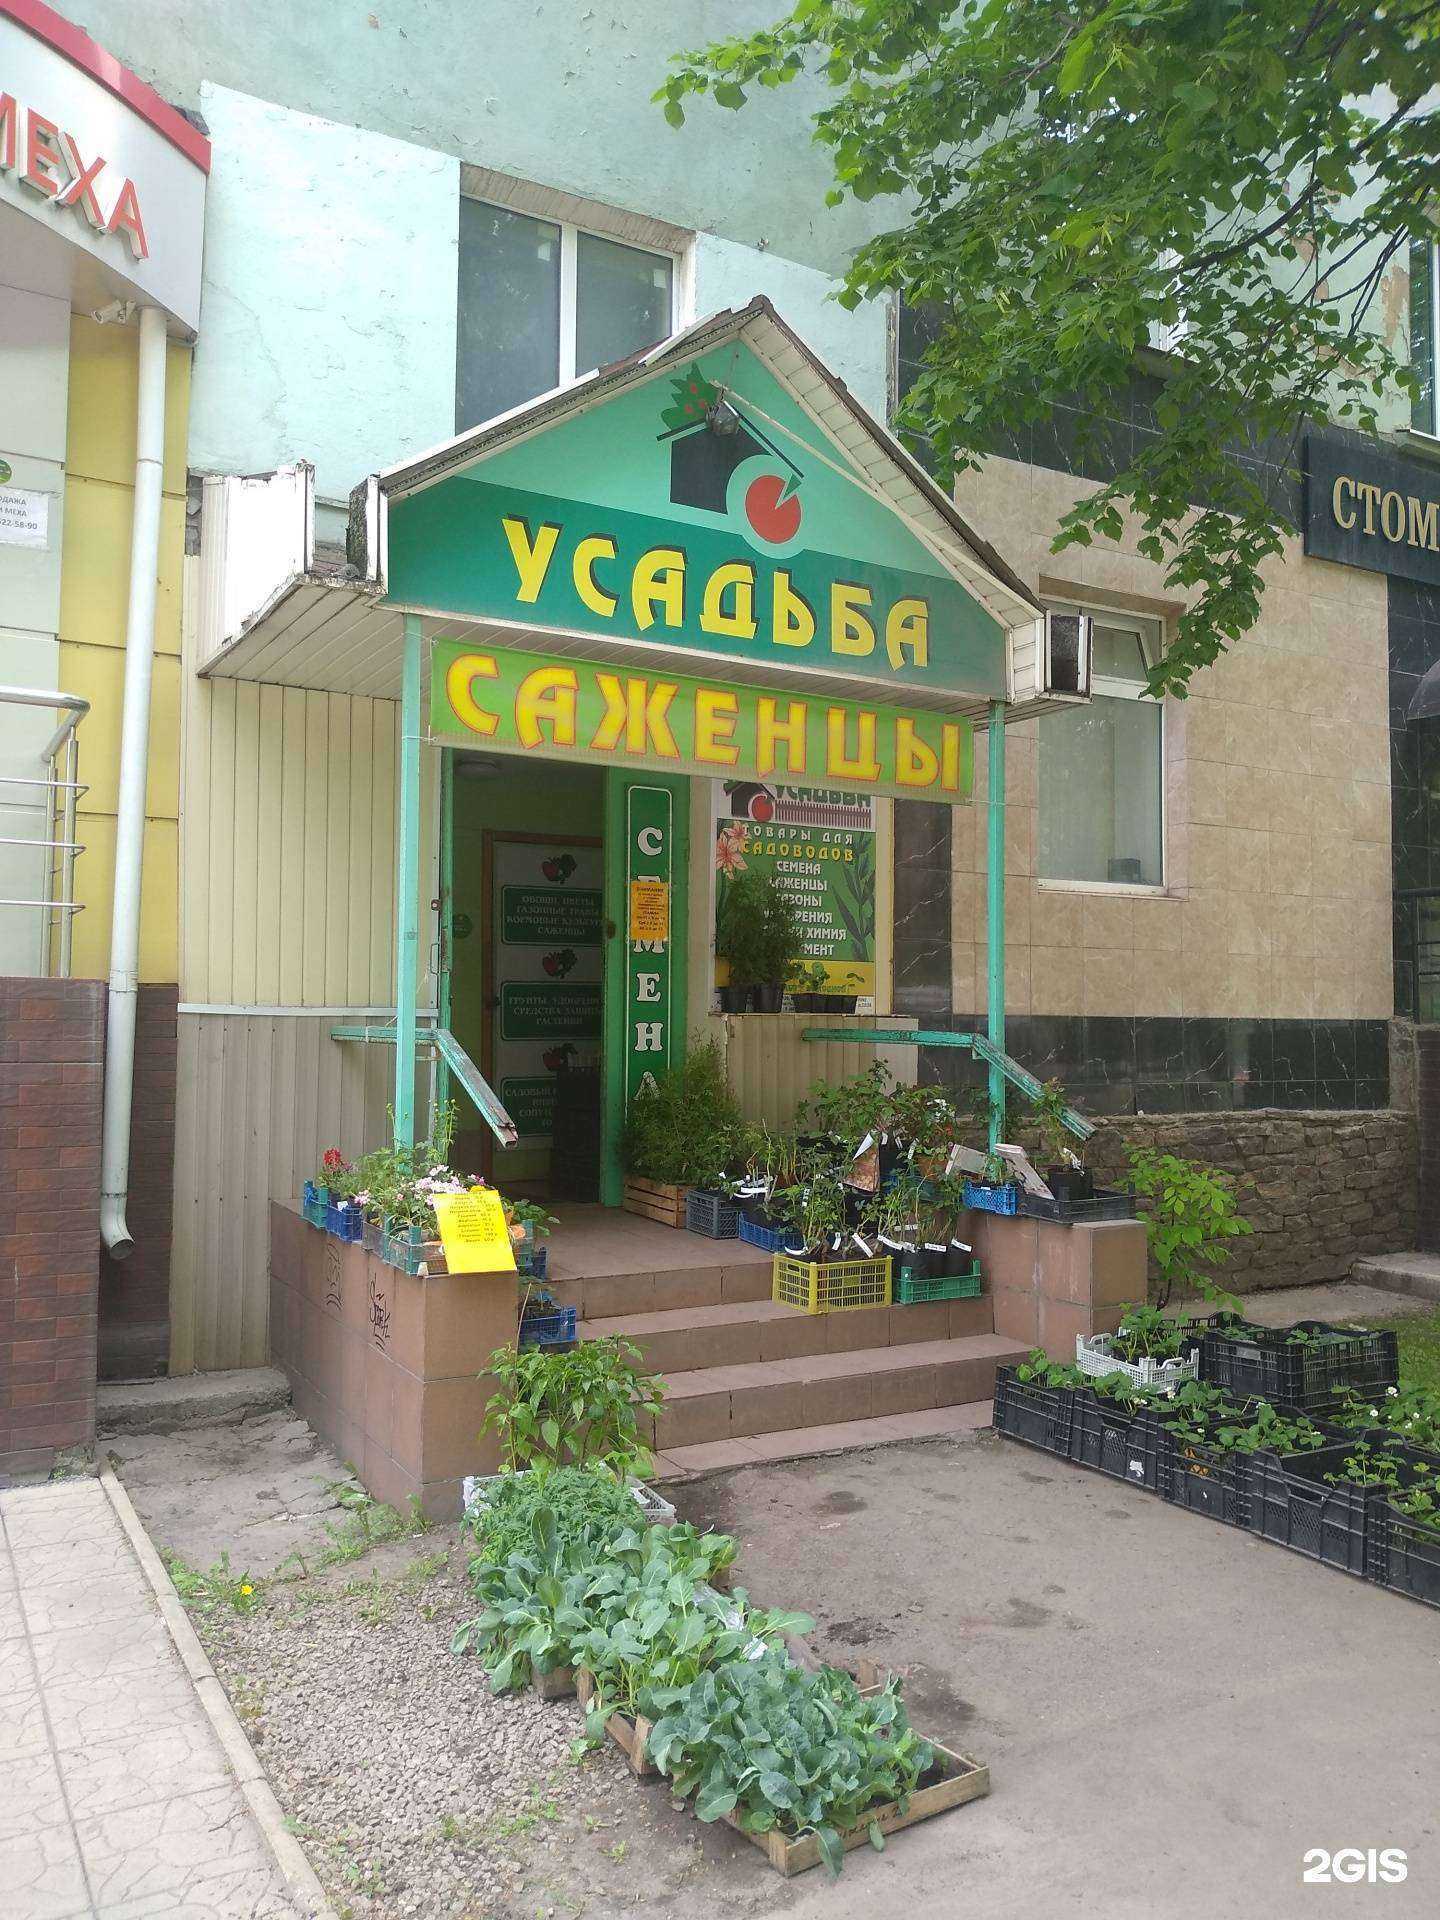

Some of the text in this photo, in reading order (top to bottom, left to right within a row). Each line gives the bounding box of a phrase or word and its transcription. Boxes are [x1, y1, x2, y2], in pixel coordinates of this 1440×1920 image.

[0, 519, 38, 530] 22-58-90
[1333, 476, 1440, 552] СТОМ
[501, 516, 932, 671] УСАДЬБА
[446, 654, 961, 792] САЖЕНЦЫ
[743, 825, 853, 845] ТОВАРЫ ДЛЯ
[741, 840, 854, 862] САДОВОДОВ
[777, 861, 822, 875] СЕМЕНА
[806, 927, 847, 941] ХИМИЯ
[634, 826, 664, 1101] СЕНА
